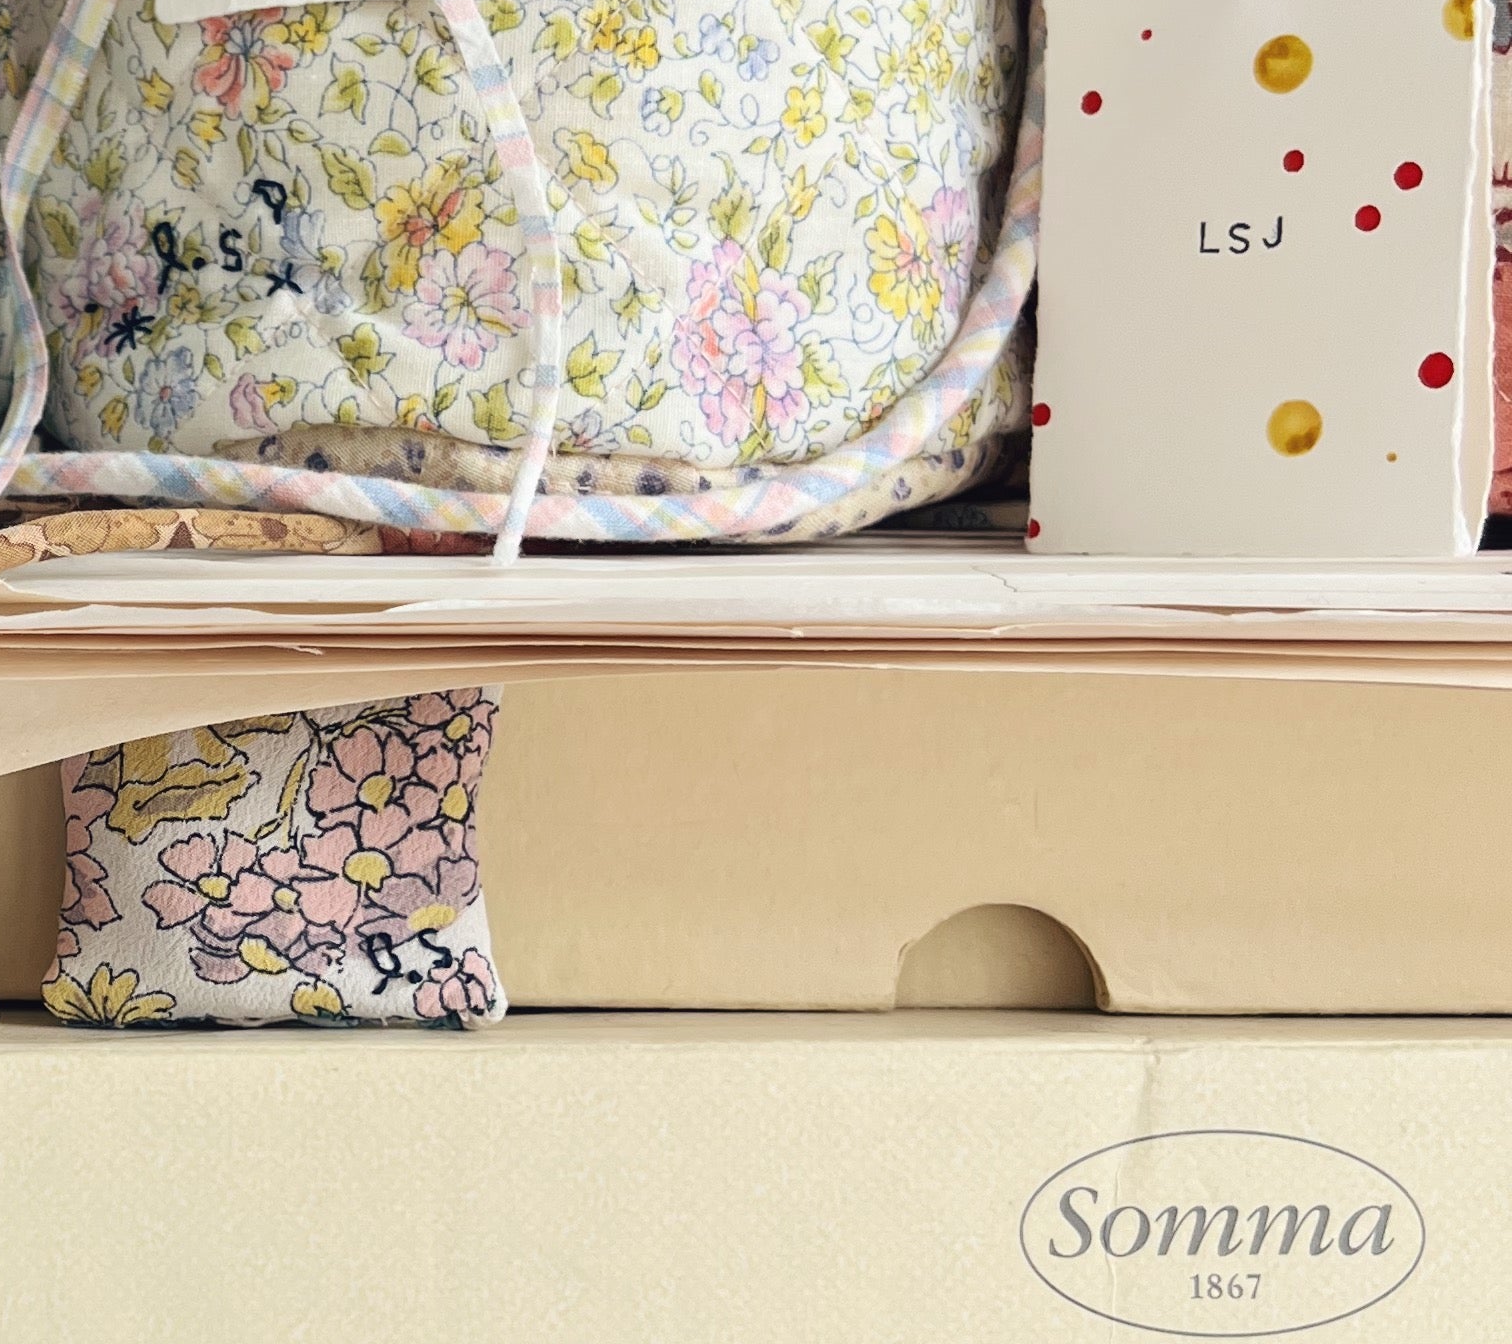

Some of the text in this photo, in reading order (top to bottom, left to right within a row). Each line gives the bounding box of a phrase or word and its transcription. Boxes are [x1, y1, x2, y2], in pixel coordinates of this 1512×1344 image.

[1199, 215, 1283, 254] LSJ
[1048, 1185, 1395, 1259] Somma
[1189, 1272, 1262, 1300] 1867
